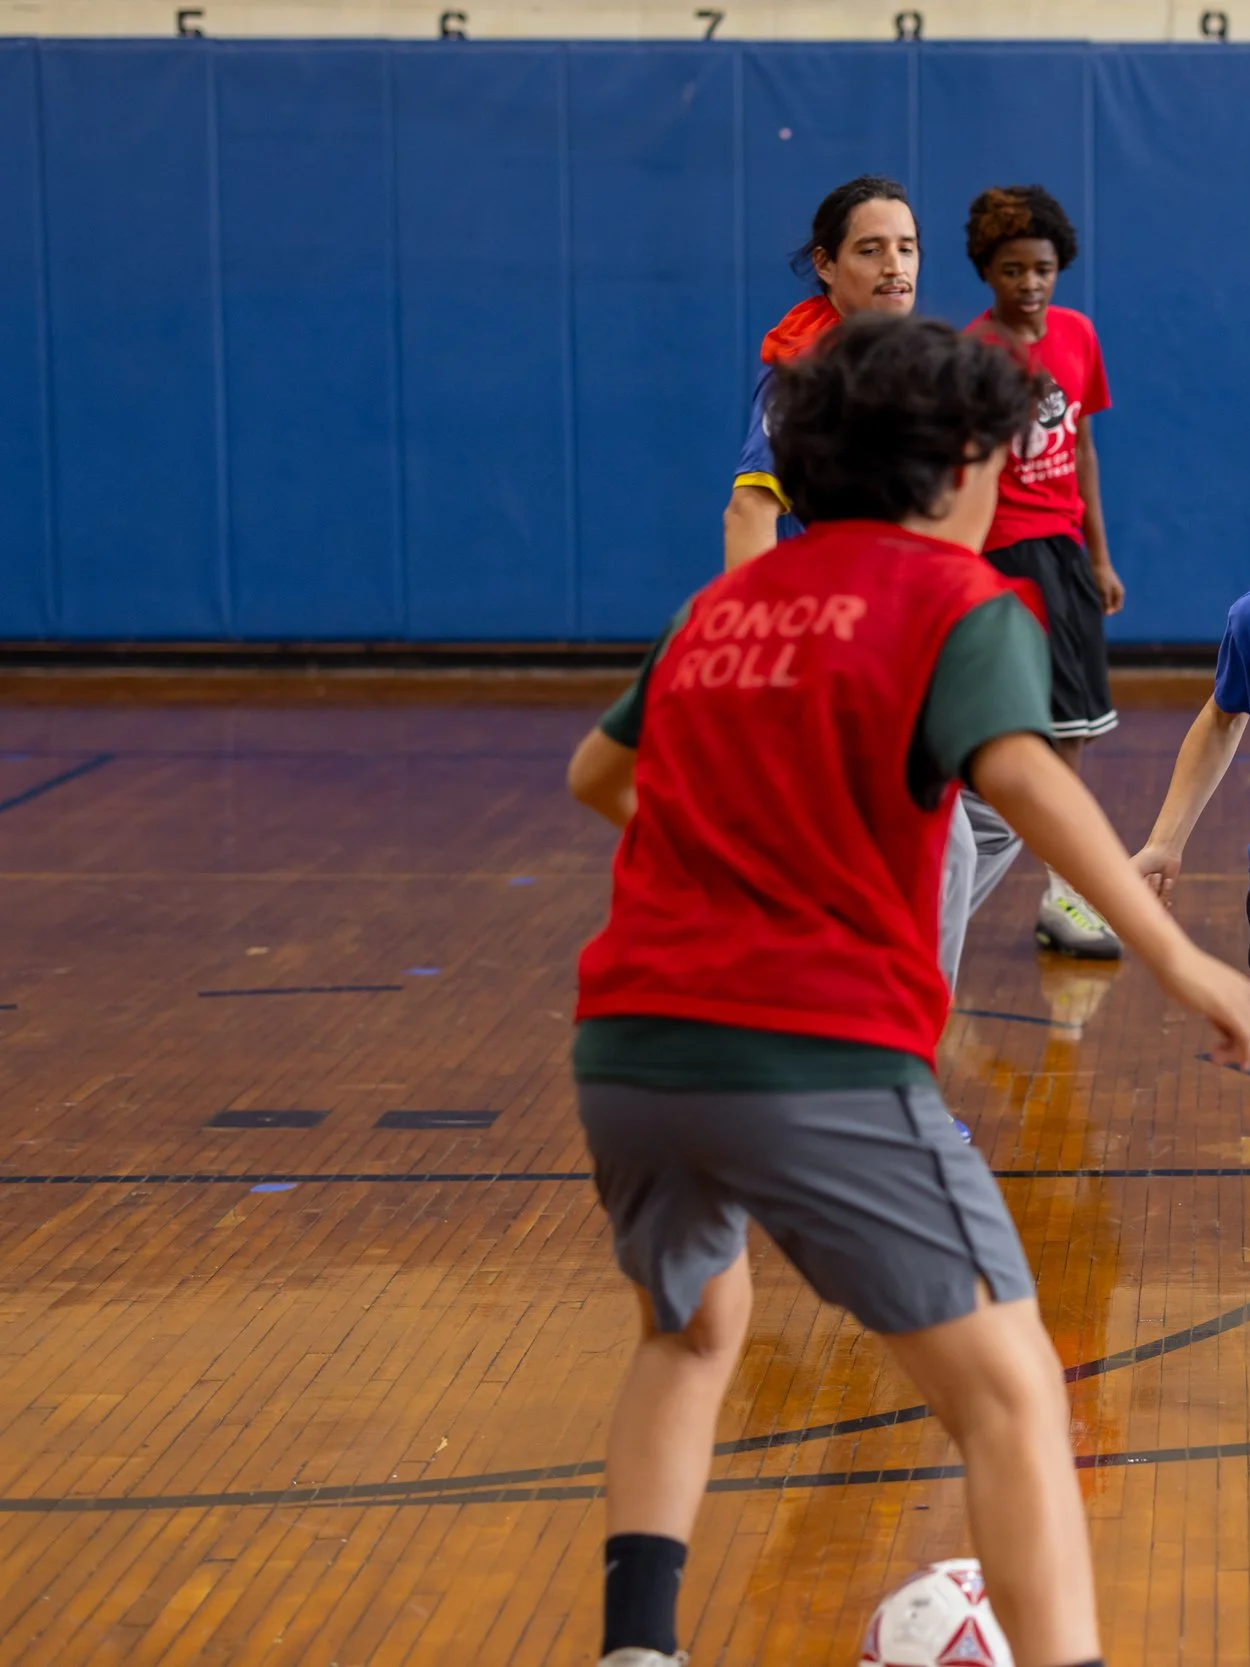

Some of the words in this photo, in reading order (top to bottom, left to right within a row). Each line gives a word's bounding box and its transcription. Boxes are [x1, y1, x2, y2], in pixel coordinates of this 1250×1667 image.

[176, 9, 206, 38] 5
[440, 9, 468, 40] 6
[694, 9, 725, 40] 7
[1200, 10, 1229, 42] 9
[686, 593, 868, 642] ONOR
[669, 642, 800, 691] ROLL
